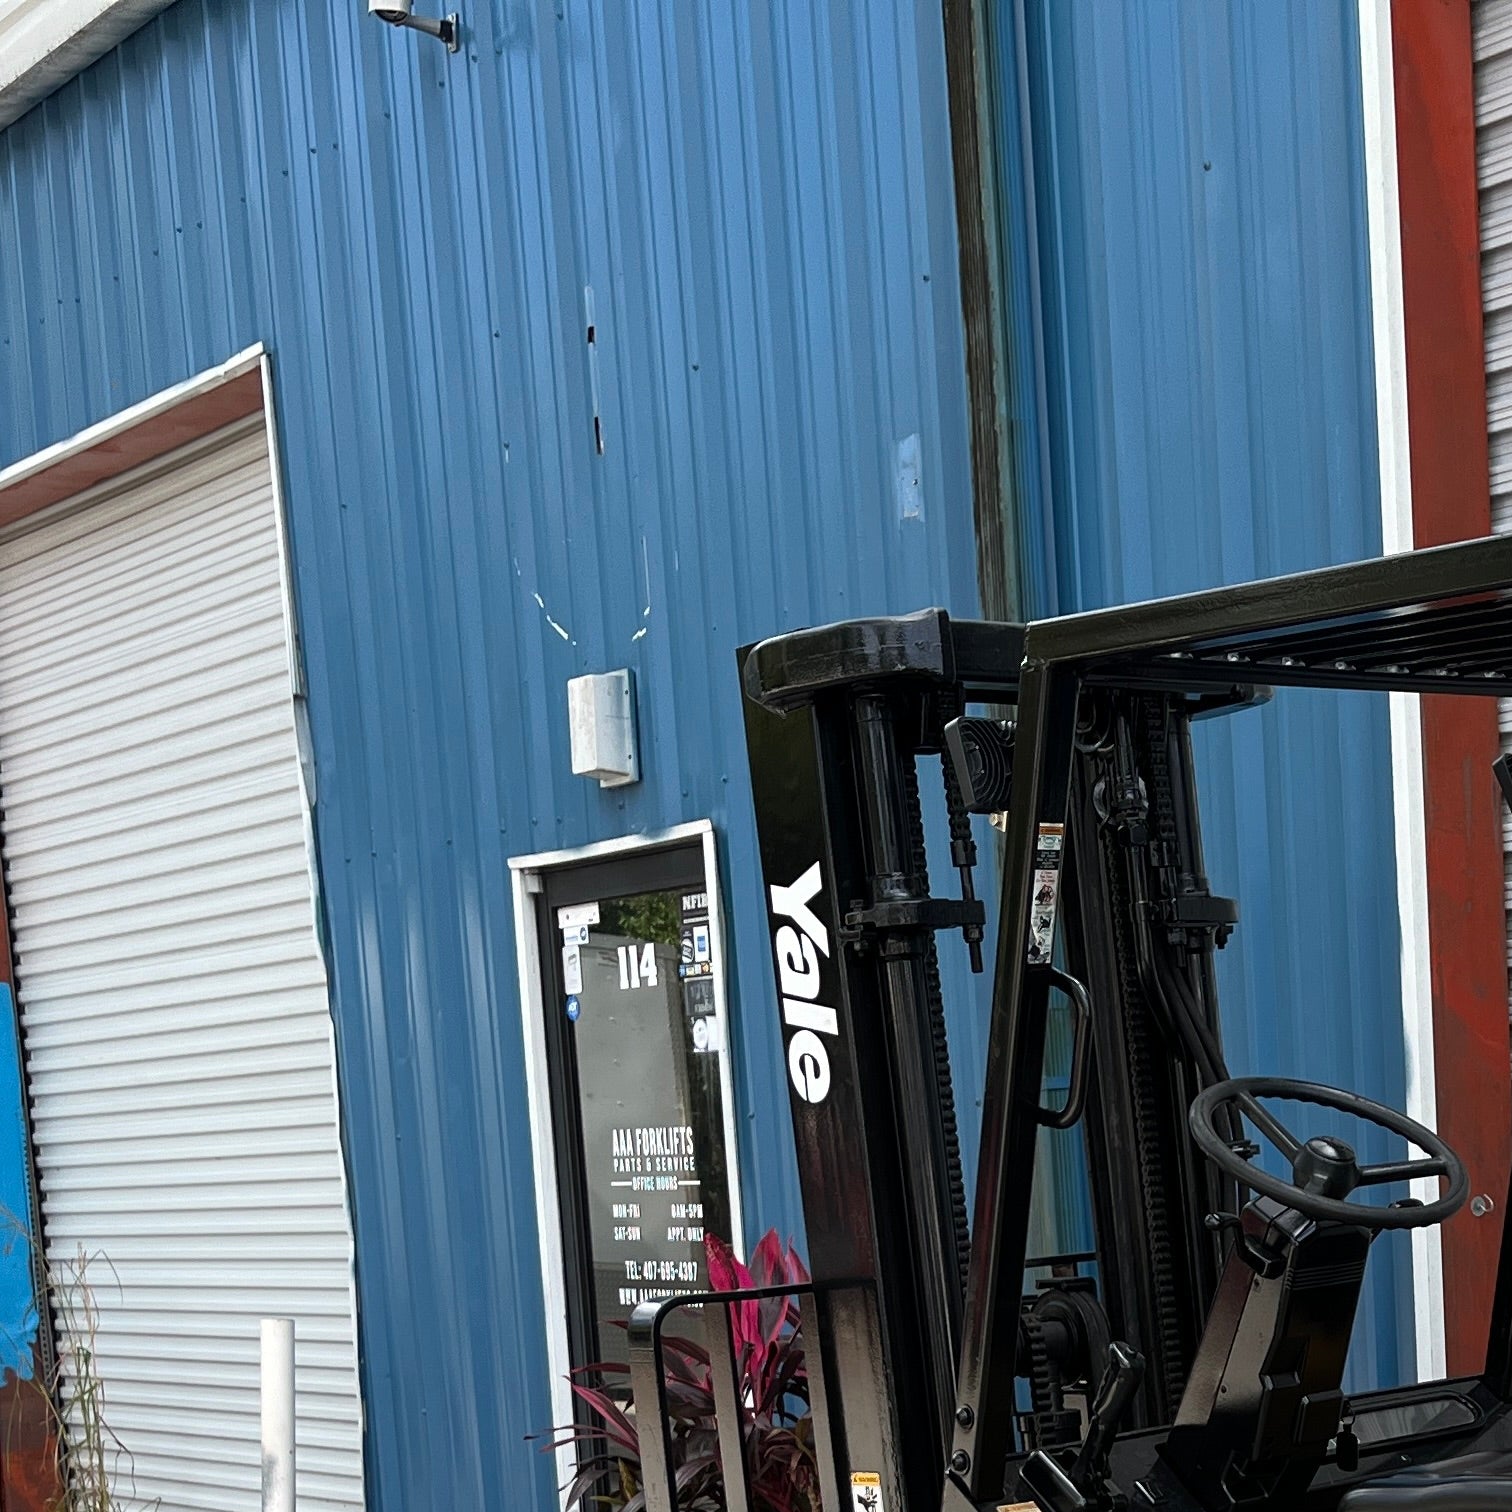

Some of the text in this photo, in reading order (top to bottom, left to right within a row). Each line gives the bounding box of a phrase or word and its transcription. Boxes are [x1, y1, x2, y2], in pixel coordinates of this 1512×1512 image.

[617, 942, 658, 990] 114
[770, 861, 838, 1104] Yale
[612, 1126, 695, 1157] AAA FORKLIFTS
[613, 1157, 642, 1173] PARTS
[655, 1156, 696, 1172] SERVICE
[632, 1175, 678, 1191] OFFICE HOURS
[614, 1226, 641, 1241] SAT-SUN
[624, 1260, 642, 1280] TEL:
